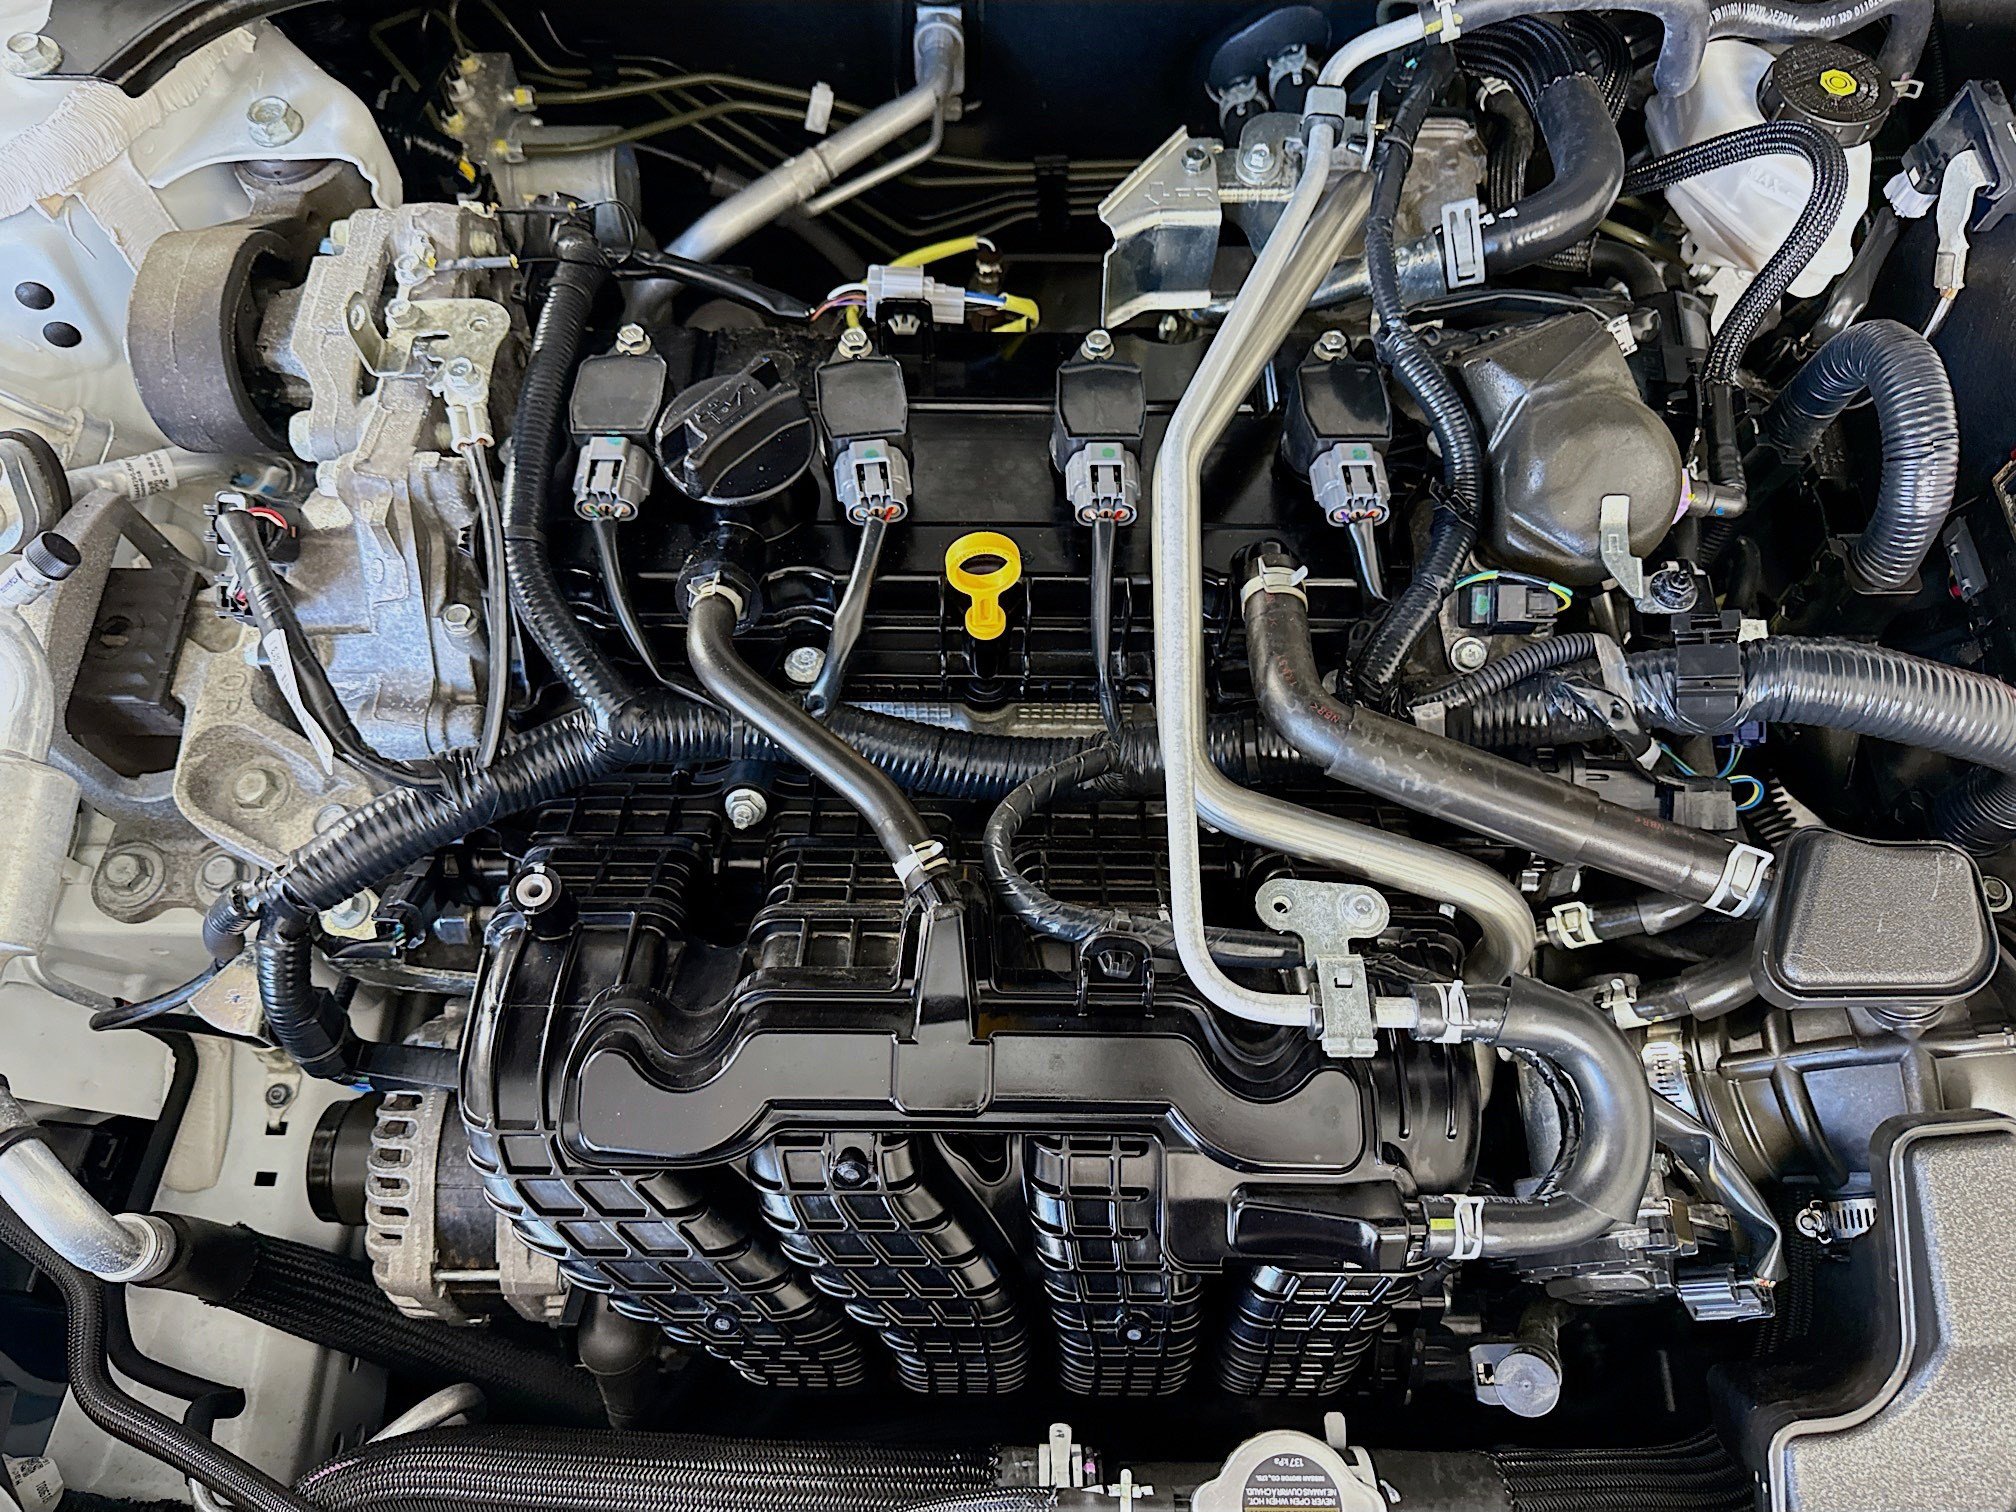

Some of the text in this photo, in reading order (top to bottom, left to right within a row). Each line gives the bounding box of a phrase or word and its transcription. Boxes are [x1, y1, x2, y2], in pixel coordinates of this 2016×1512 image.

[1274, 1457, 1304, 1467] 137 kPa
[1248, 1497, 1336, 1506] NEVER OPEN WHEN HOT.
